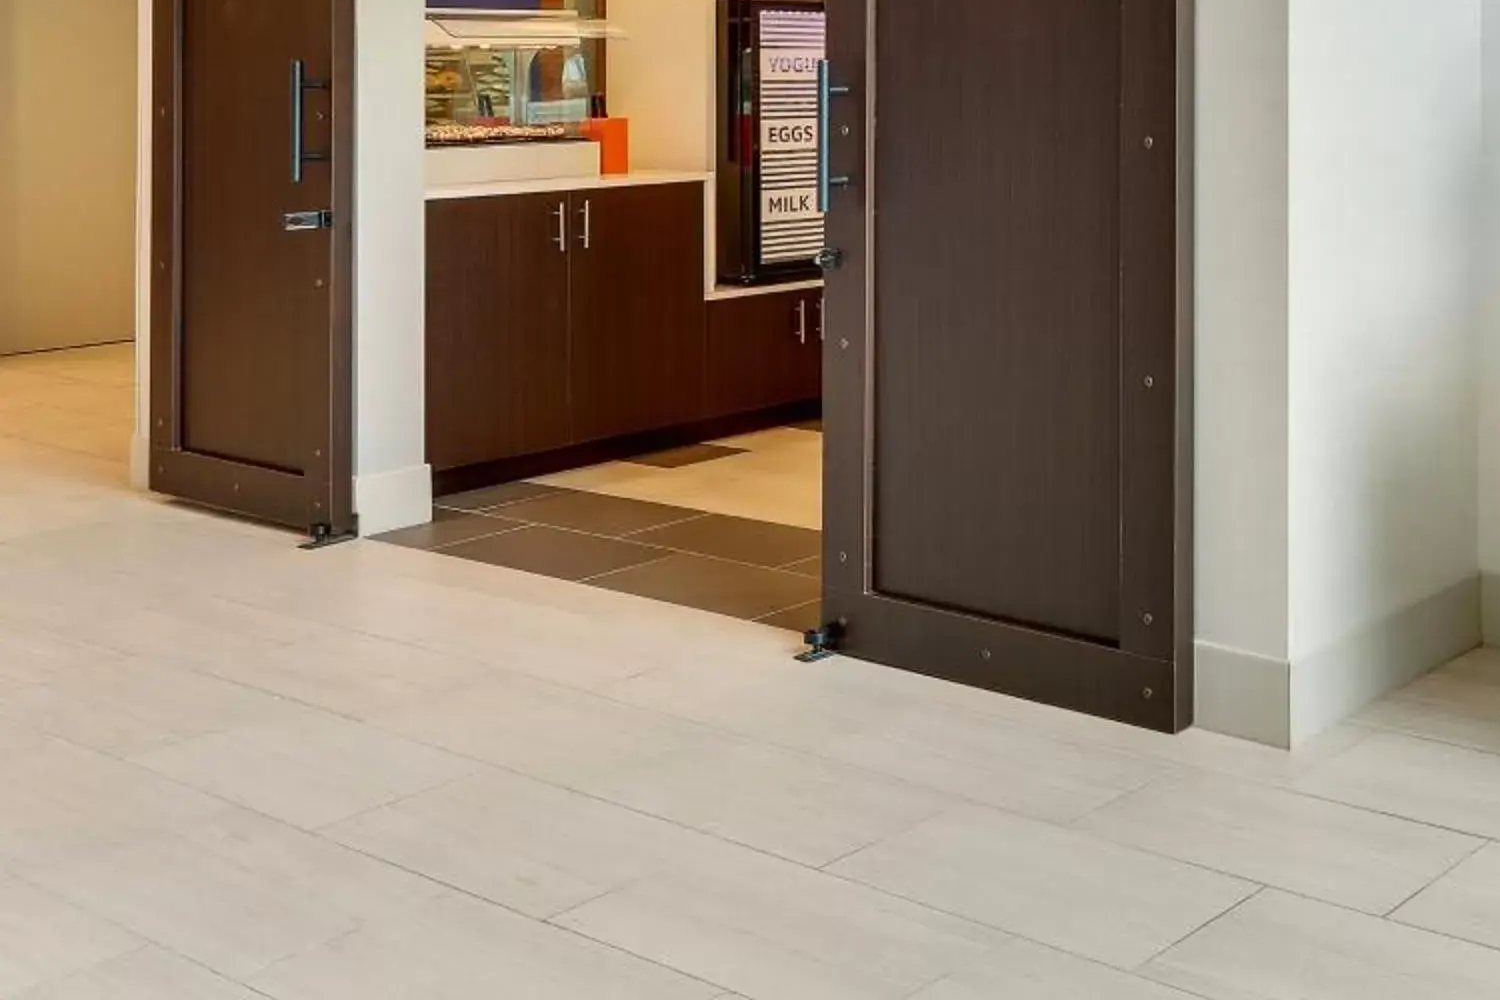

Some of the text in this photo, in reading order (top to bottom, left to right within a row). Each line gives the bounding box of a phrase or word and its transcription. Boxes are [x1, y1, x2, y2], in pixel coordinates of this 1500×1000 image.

[767, 56, 818, 74] YOGU
[767, 124, 814, 144] EGGS
[768, 194, 810, 214] MILK
